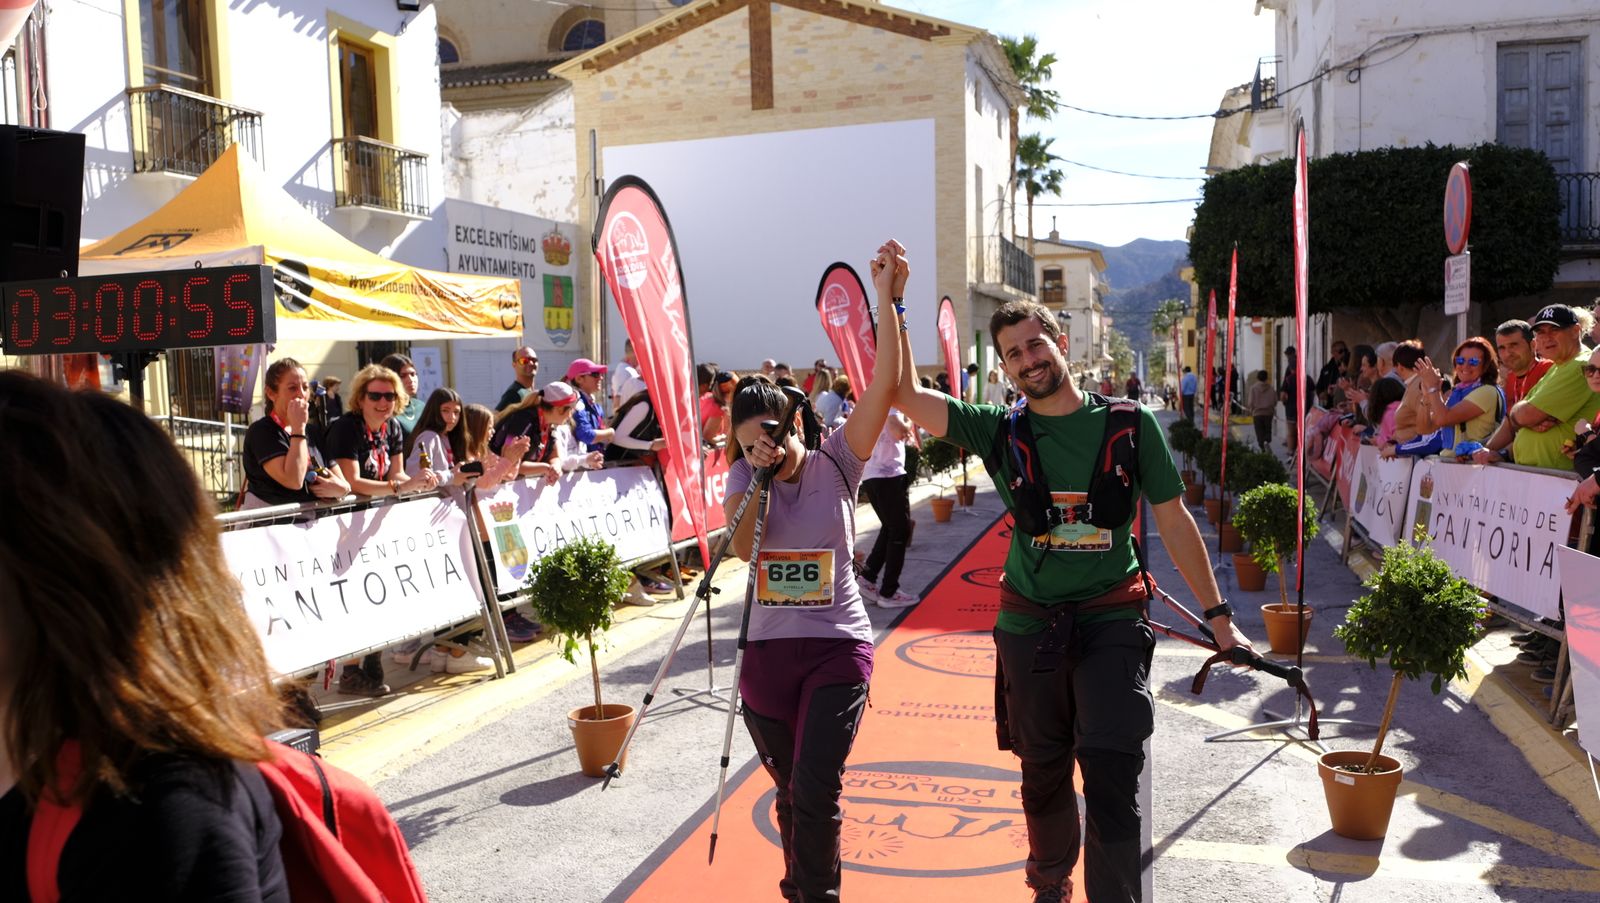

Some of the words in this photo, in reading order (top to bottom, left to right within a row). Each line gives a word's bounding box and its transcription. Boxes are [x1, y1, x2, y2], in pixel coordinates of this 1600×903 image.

[455, 225, 536, 254] EXCELENTÍSIMO
[458, 253, 536, 279] AYUNTAMIENTO
[11, 273, 255, 347] 03:00:55
[727, 479, 758, 541] ULTRALITE
[1535, 511, 1557, 532] DE
[425, 529, 447, 548] DE
[534, 504, 661, 554] CANTORIA
[768, 563, 819, 582] 626
[264, 553, 462, 636] ANTORIA
[900, 701, 994, 711] antoria
[842, 777, 996, 798] POLVOR
[845, 770, 933, 783] Cantoria
